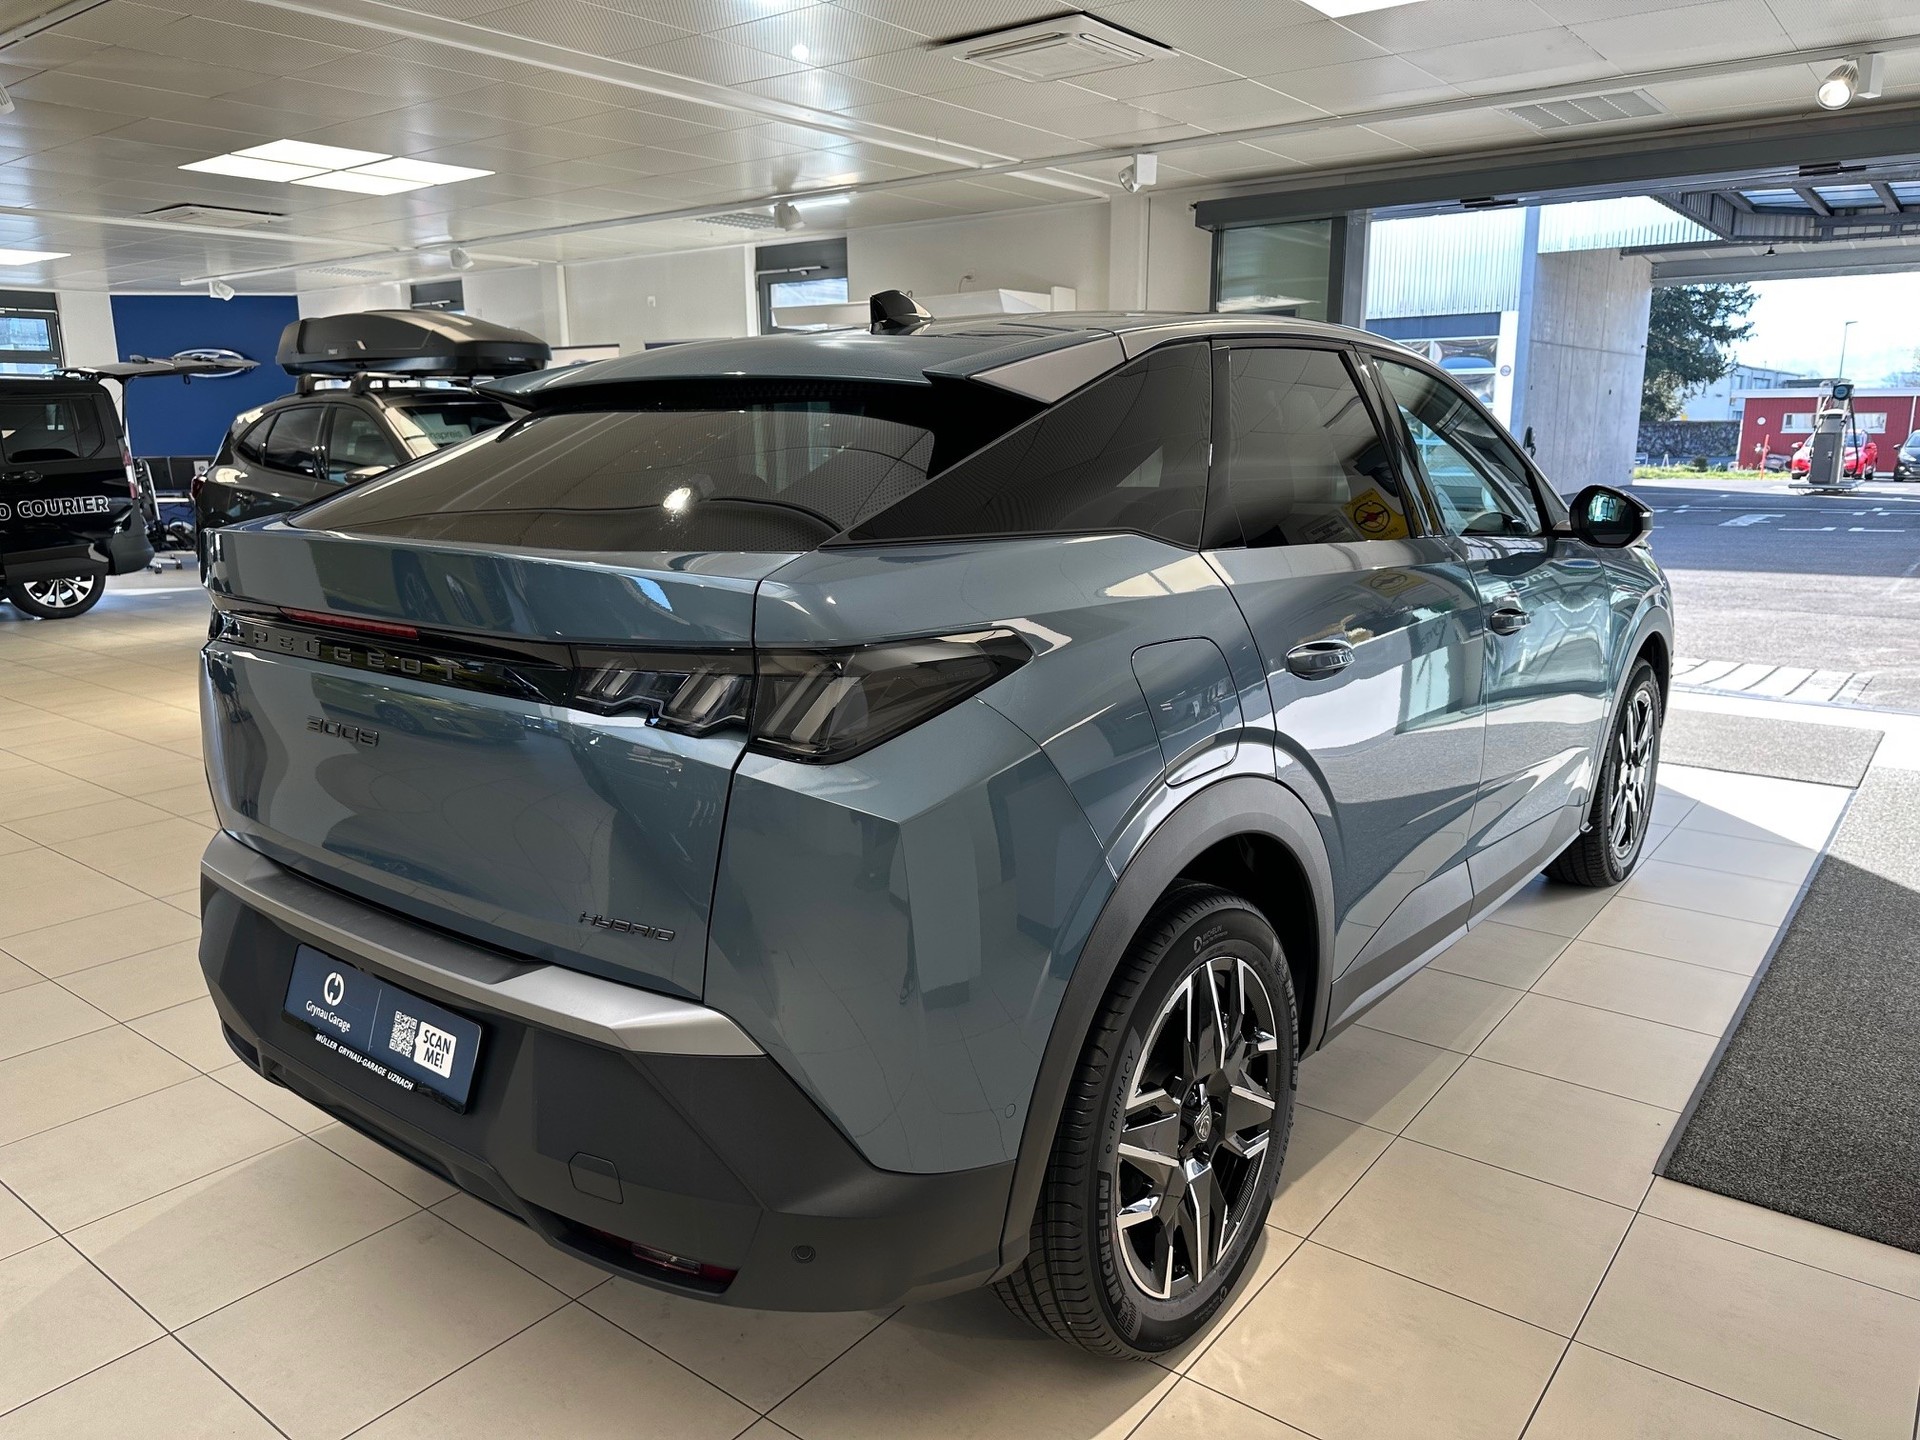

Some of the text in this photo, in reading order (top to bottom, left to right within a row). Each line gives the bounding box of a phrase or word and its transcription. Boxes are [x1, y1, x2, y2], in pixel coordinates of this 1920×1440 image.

[17, 495, 110, 518] COURIER
[253, 630, 461, 682] PEUGEOT
[306, 714, 380, 748] 3008
[579, 911, 676, 941] HYBRID
[306, 1000, 351, 1033] Grynau Garage
[1284, 979, 1299, 1085] MICHELIN
[423, 1029, 452, 1055] SCAN
[315, 1032, 414, 1091] MÜLLER GRYNAU-GARAGE UZNACH
[423, 1050, 445, 1069] ME!
[1098, 1179, 1123, 1305] MICHELIN
